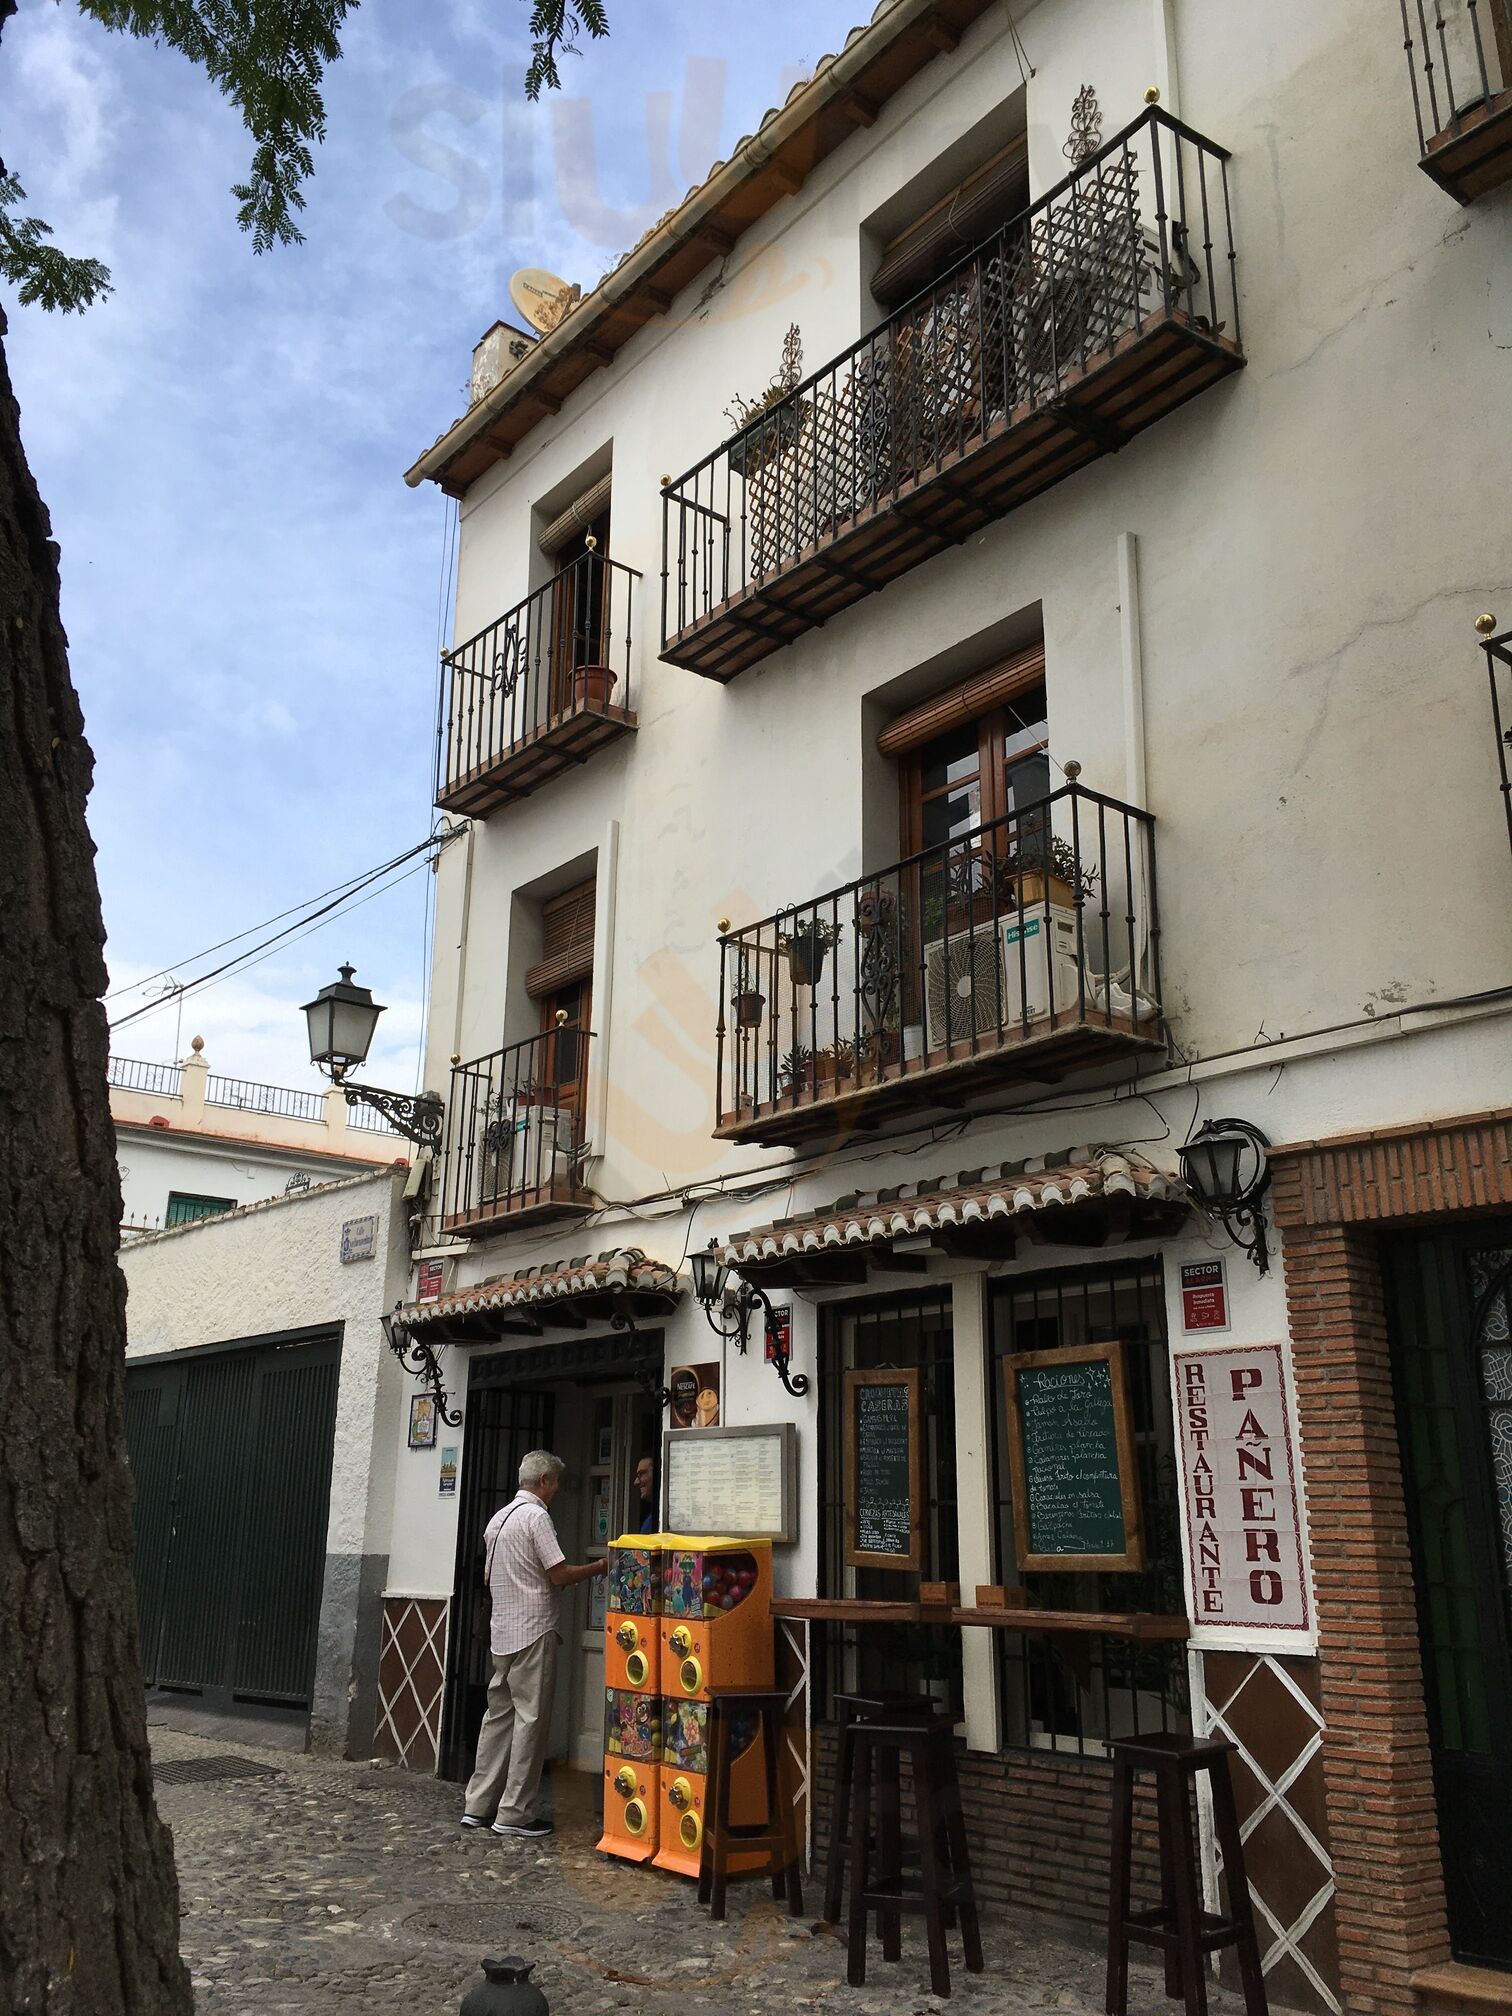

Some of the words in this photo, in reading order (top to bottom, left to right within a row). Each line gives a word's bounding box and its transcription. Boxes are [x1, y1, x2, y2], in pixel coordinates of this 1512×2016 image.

[1007, 924, 1038, 940] Hisnse
[1184, 1265, 1219, 1277] SECTOR
[1185, 1363, 1223, 1612] RESTAURANTE
[1229, 1368, 1284, 1605] PAÑERO
